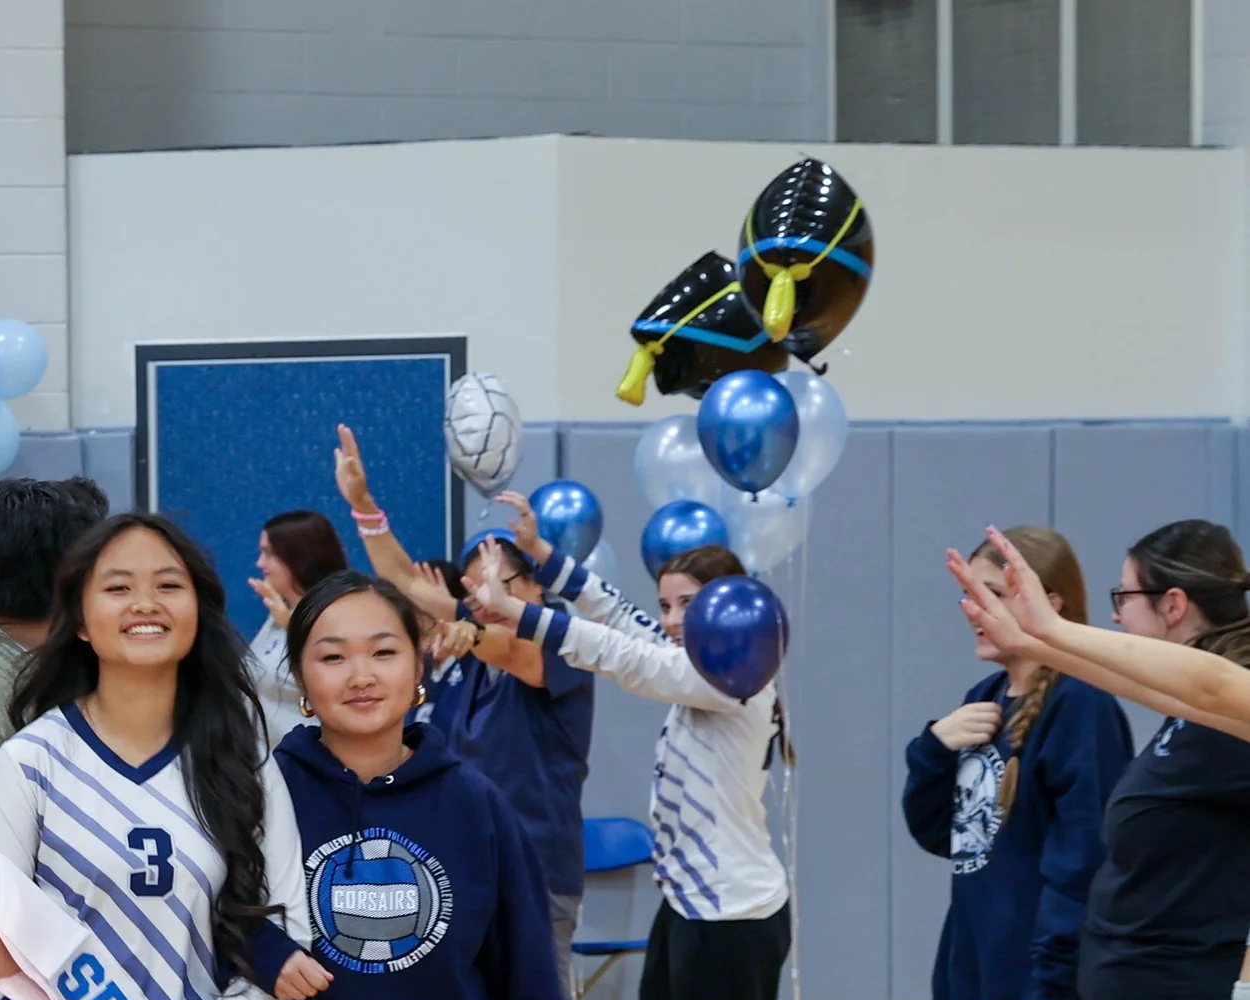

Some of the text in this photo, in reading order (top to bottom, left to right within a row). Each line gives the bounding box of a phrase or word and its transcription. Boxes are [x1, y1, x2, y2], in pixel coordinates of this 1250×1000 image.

[126, 826, 175, 897] 3
[363, 827, 429, 861] MOTT VOLLEYBALL
[334, 889, 417, 911] CORSAIRS
[425, 856, 453, 920] MOTT VOLLEYBALL
[387, 920, 449, 973] MOTT VOLLEYBALL
